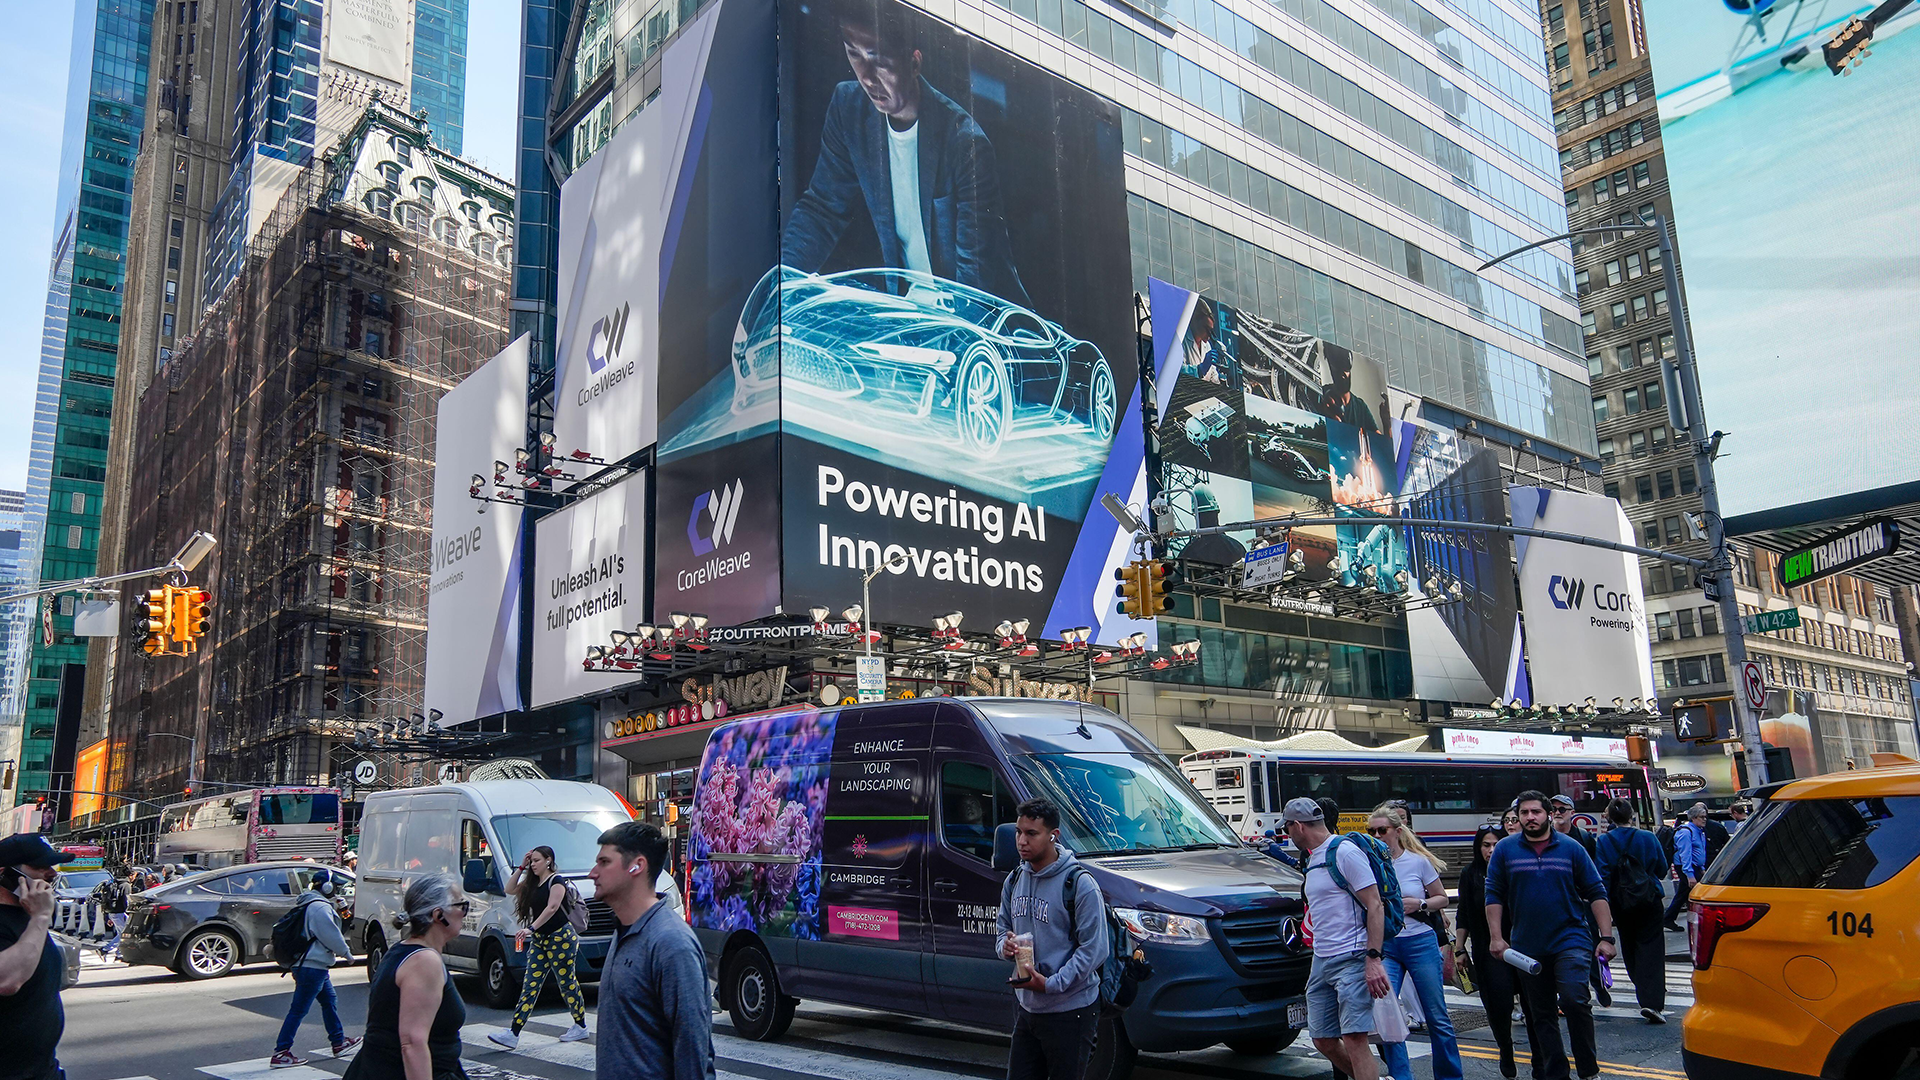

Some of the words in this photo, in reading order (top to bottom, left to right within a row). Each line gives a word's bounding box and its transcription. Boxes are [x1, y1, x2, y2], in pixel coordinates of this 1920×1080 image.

[340, 0, 401, 23] MASTERFULLY
[345, 7, 396, 30] COMBINED.
[577, 361, 635, 407] CoreWeave
[818, 464, 1004, 544] Powering
[1011, 501, 1046, 542] AI
[818, 523, 1044, 593] Innovations
[1256, 550, 1268, 559] BUS
[1269, 545, 1285, 555] LANE
[551, 563, 597, 600] Unleash
[600, 553, 625, 582] AI's
[677, 550, 751, 592] CoreWeave
[546, 605, 565, 631] full
[566, 583, 627, 630] potential.
[1271, 595, 1334, 615] #OUTFRONTPRIME
[1590, 616, 1630, 632] Powering
[1759, 615, 1769, 630] W
[1772, 612, 1788, 627] 42
[1788, 610, 1796, 621] St
[709, 622, 850, 643] #OUTFRONTPRME
[861, 658, 880, 666] NYPD
[853, 739, 904, 754] ENHANCE
[1451, 732, 1466, 747] pink
[1509, 735, 1523, 750] pink
[357, 766, 375, 779] JD
[863, 761, 891, 775] YOUR
[413, 777, 421, 785] 25
[840, 778, 911, 792] LANDSCAPING
[1665, 780, 1680, 788] Yard
[1680, 779, 1700, 787] House
[1350, 815, 1361, 823] Your
[829, 872, 886, 885] CAMBRIDGE
[836, 911, 889, 923] CAMBRIDGENY.COM
[957, 904, 972, 918] 22-12
[1826, 910, 1875, 938] 104
